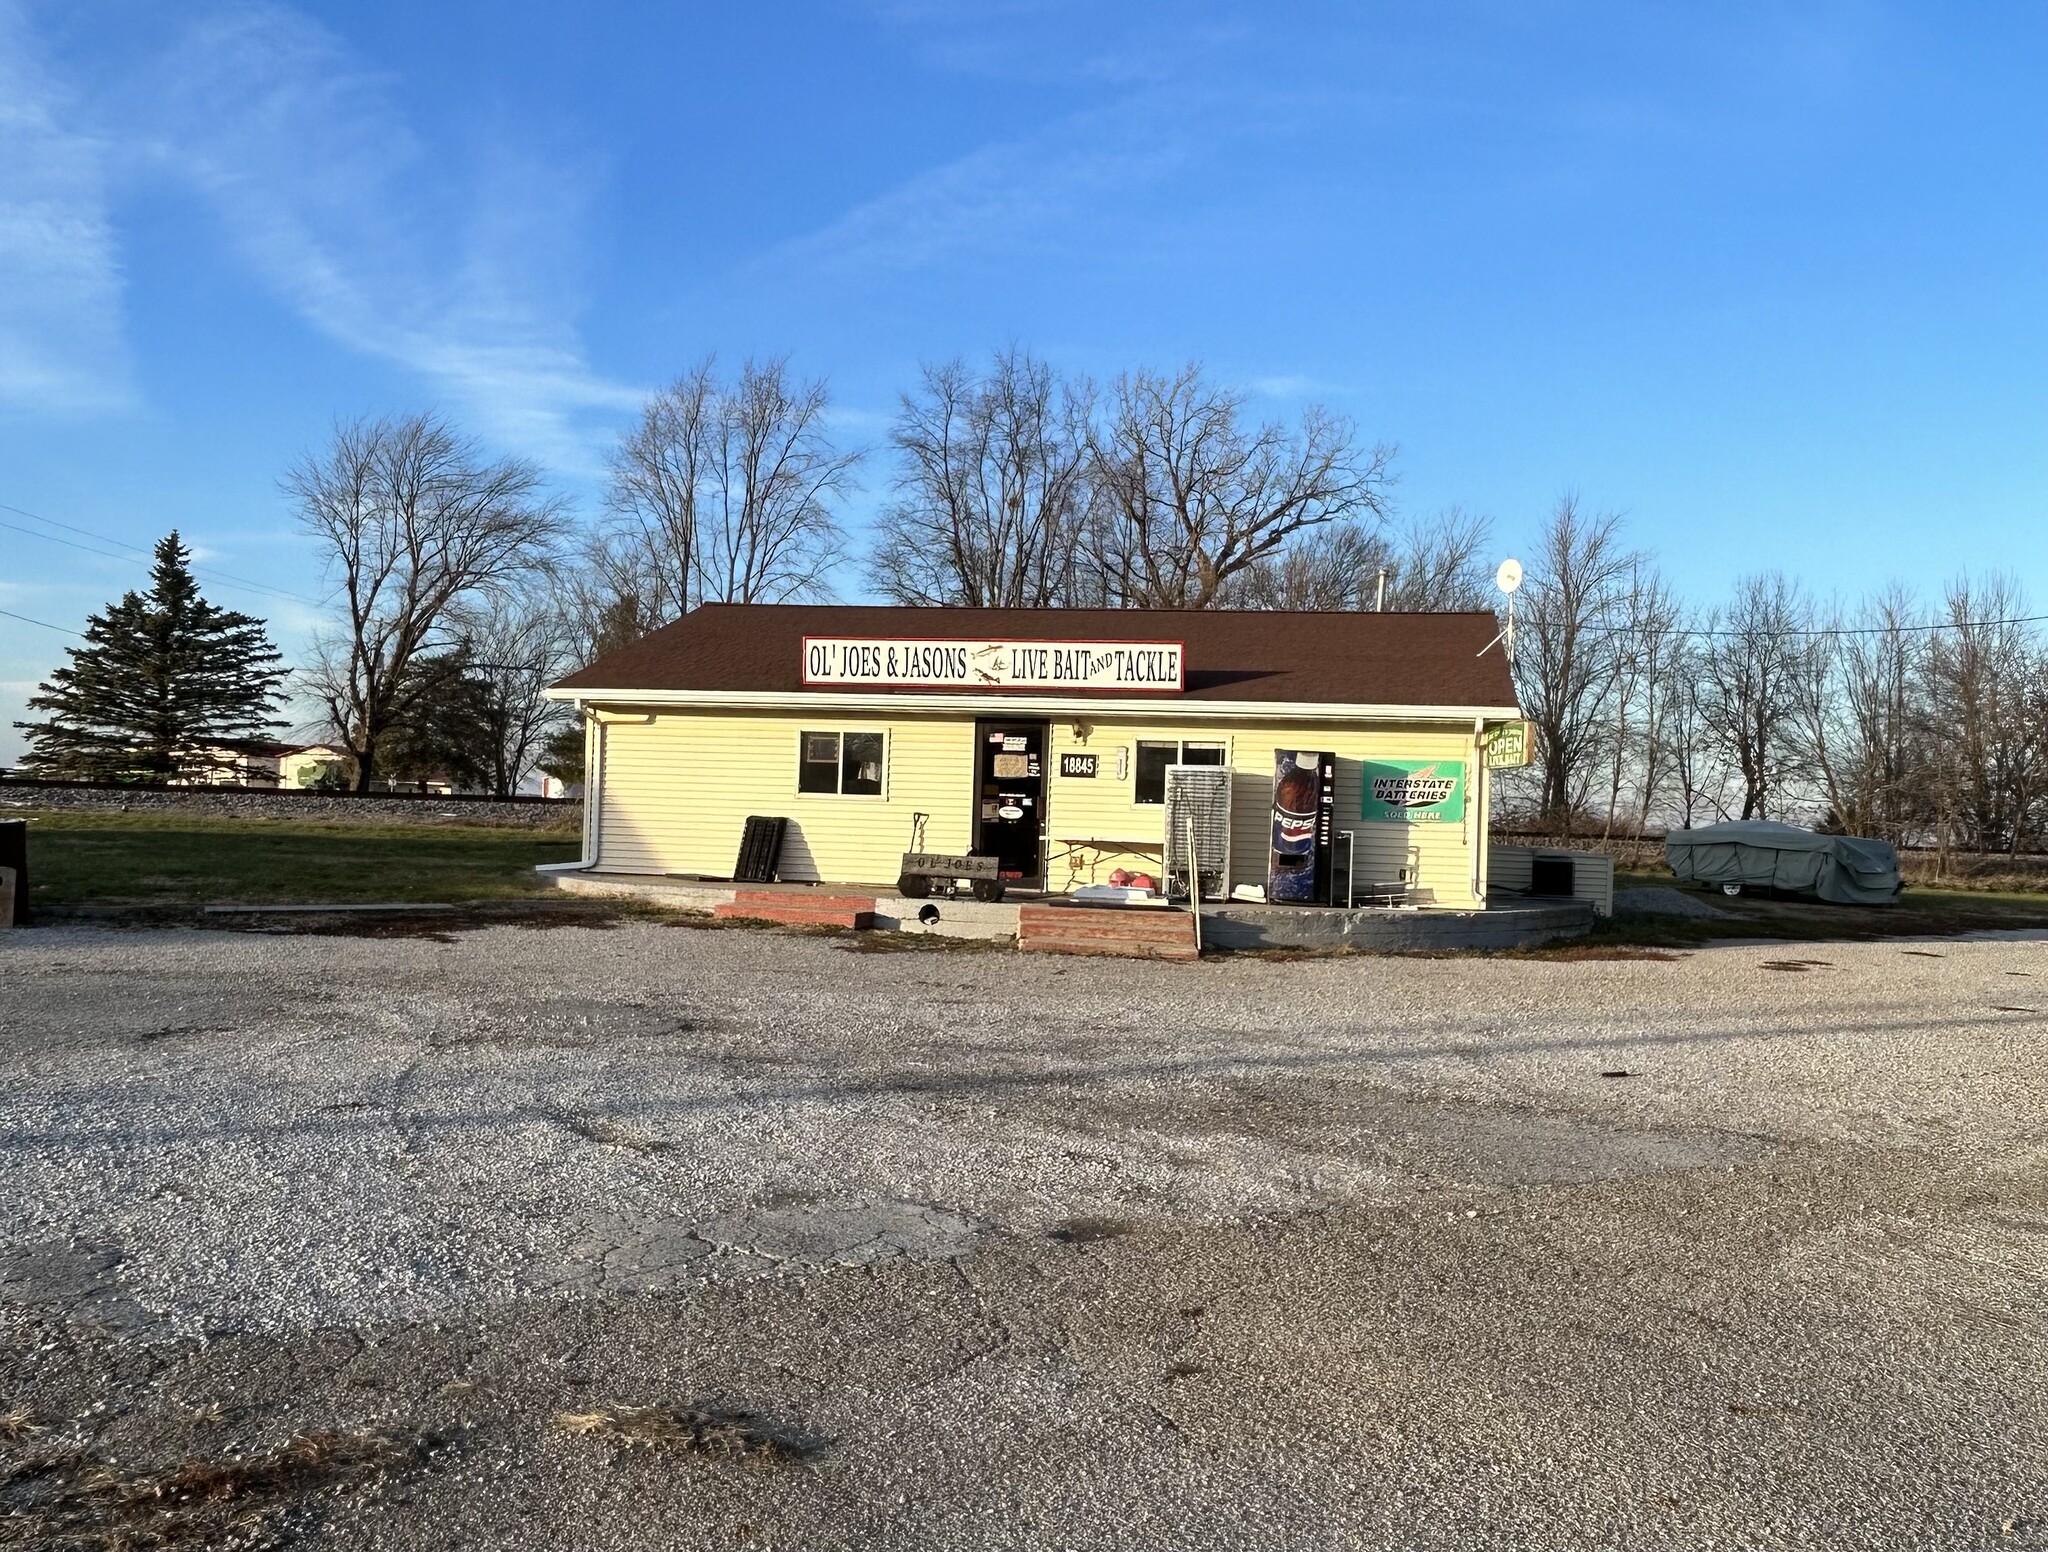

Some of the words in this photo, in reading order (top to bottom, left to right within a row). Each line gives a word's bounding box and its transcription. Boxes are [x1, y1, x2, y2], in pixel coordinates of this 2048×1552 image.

[810, 644, 836, 676] OL'
[840, 646, 881, 677] JOES
[887, 646, 898, 677] &
[902, 646, 967, 679] JASONS
[1011, 649, 1048, 679] LIVE
[1053, 649, 1091, 680] BAIT
[1090, 652, 1113, 676] AND
[1115, 650, 1178, 682] TACKLE
[1489, 736, 1522, 755] OPEN
[1064, 757, 1094, 774] 18845
[1374, 779, 1454, 789] INTERSTATE
[1375, 790, 1447, 800] BATTERIES
[1384, 811, 1412, 819] SOLD
[1413, 811, 1441, 819] HERE
[944, 858, 984, 871] JOES
